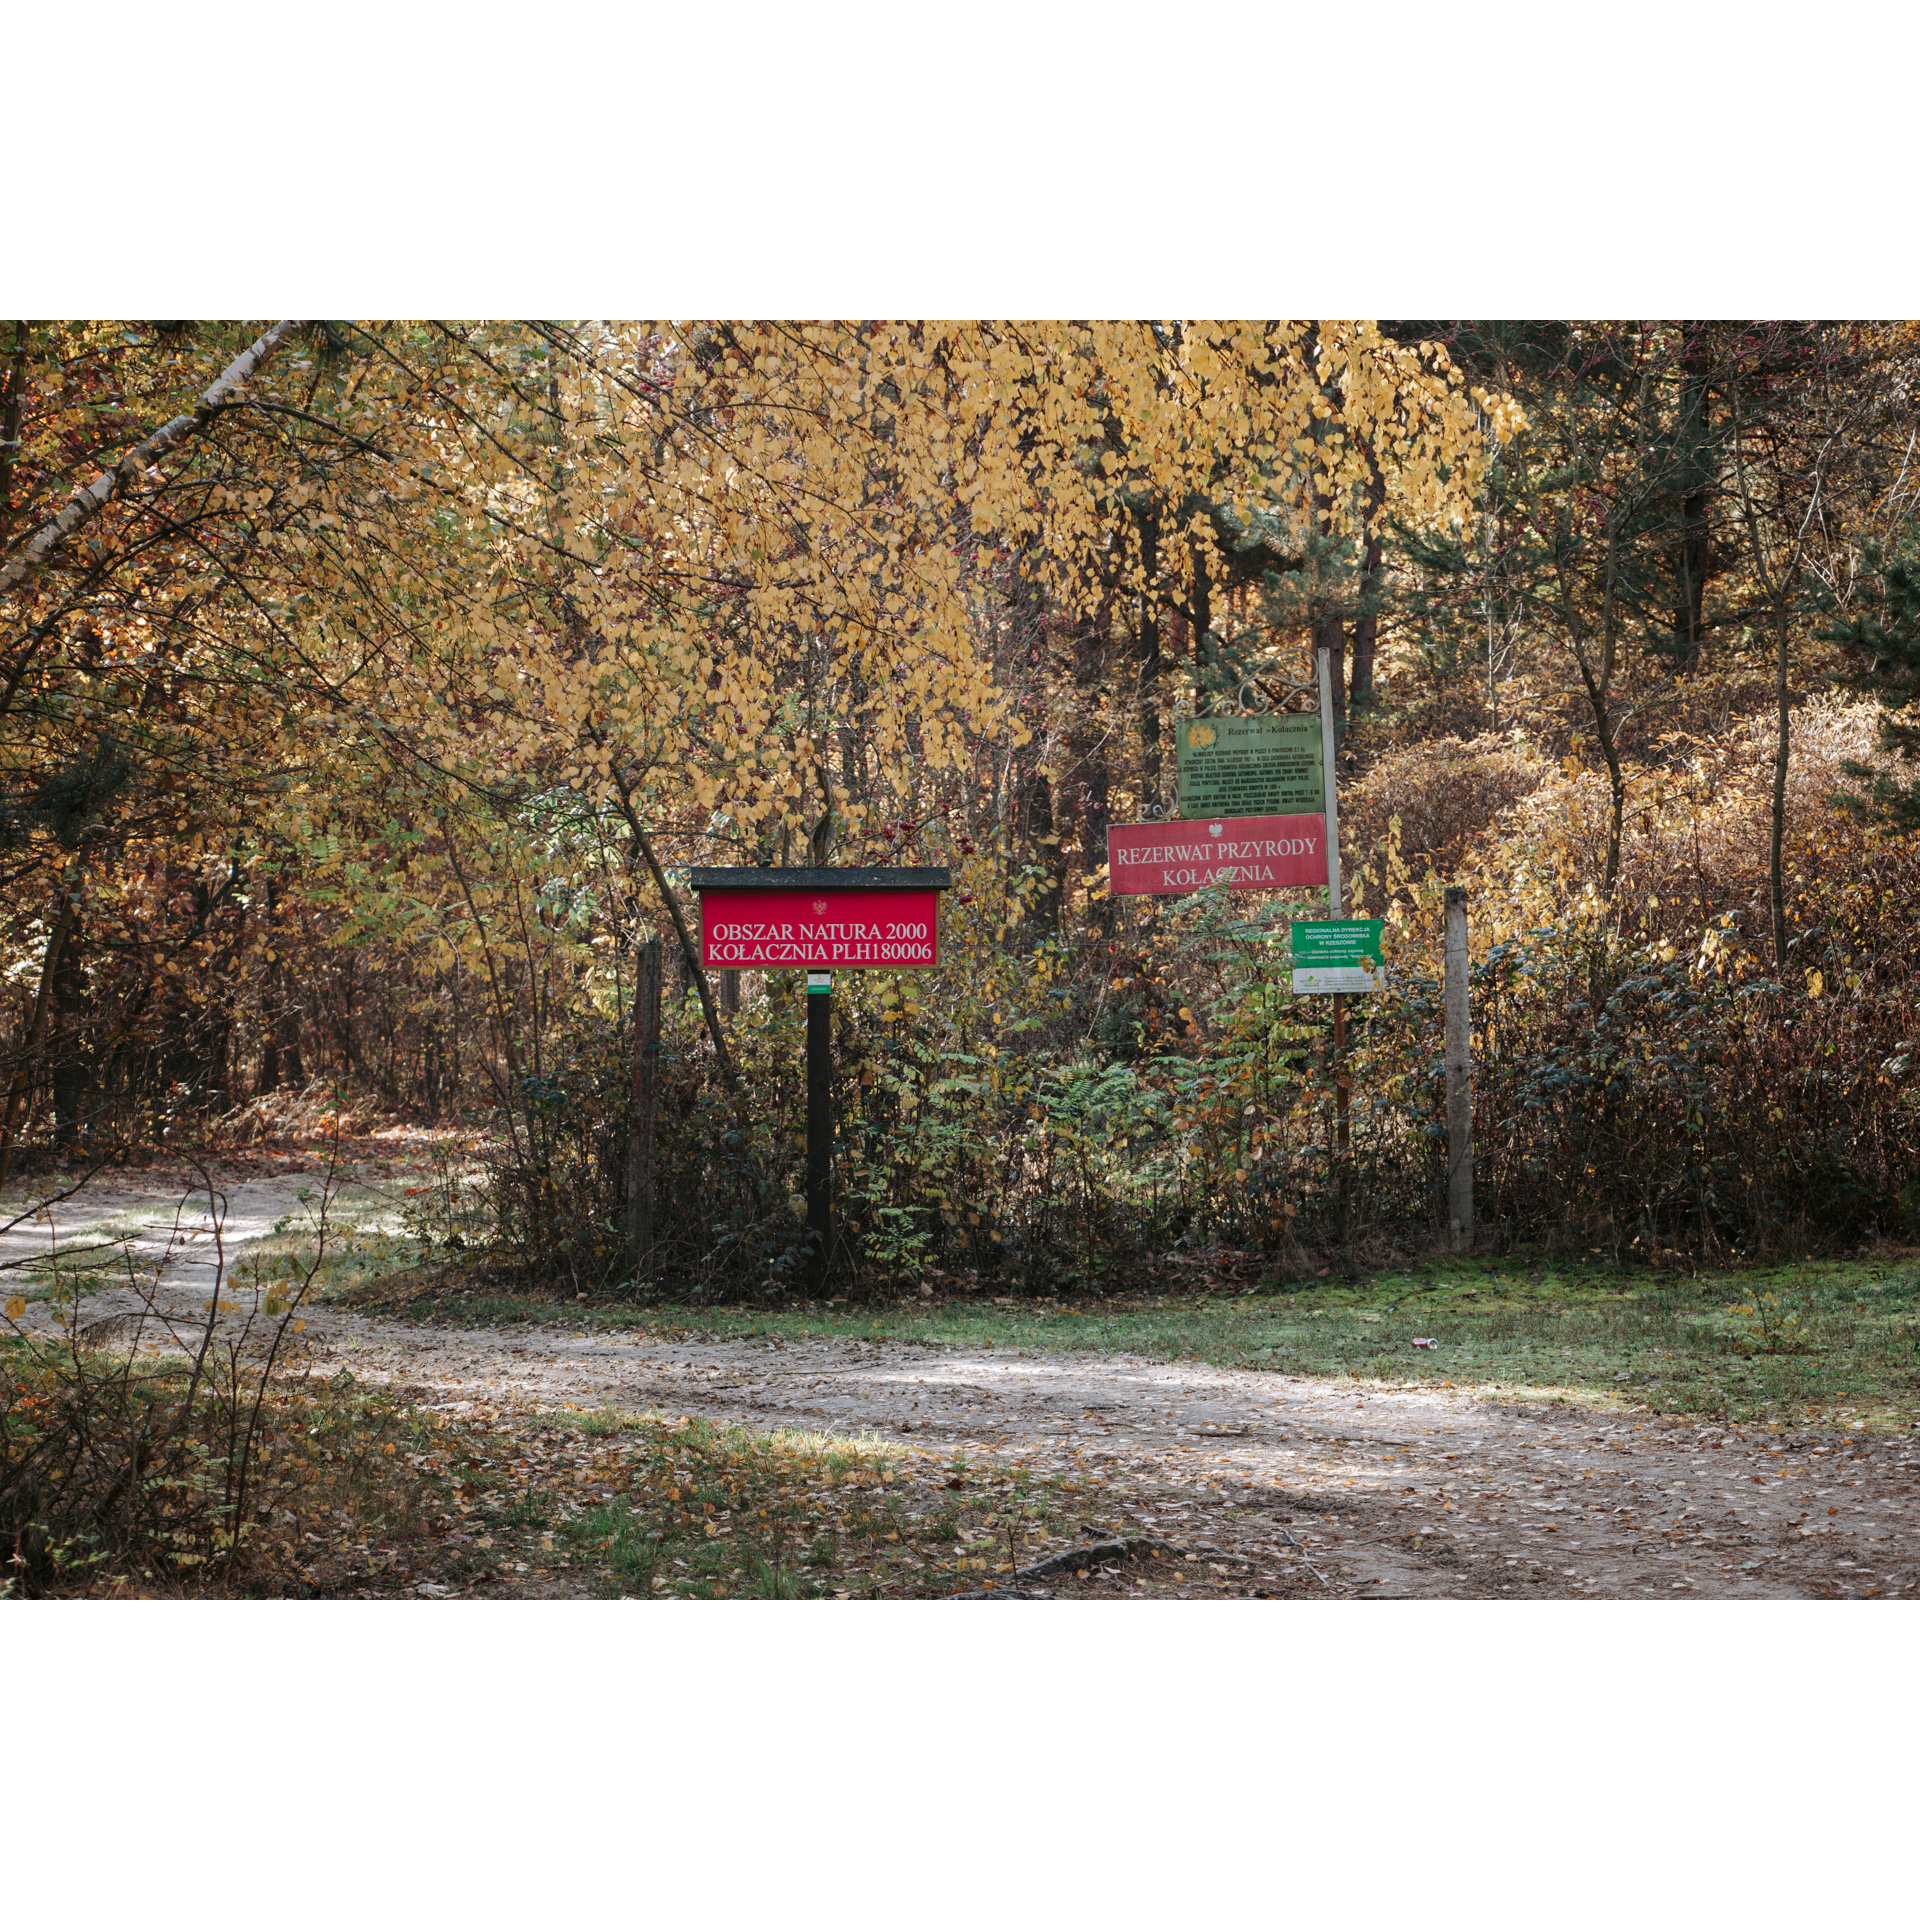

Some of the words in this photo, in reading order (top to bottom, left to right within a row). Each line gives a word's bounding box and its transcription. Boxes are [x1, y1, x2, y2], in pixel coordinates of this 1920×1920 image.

[1228, 727, 1263, 736] Rezerwat
[1117, 843, 1213, 865] REZERWAT
[1217, 837, 1317, 860] PRZYRODY
[713, 924, 795, 941] OBSZAR
[799, 923, 882, 940] NATURA
[886, 923, 927, 940] 2000
[708, 943, 829, 961] KOŁACZNIA
[832, 943, 932, 960] PLH180006
